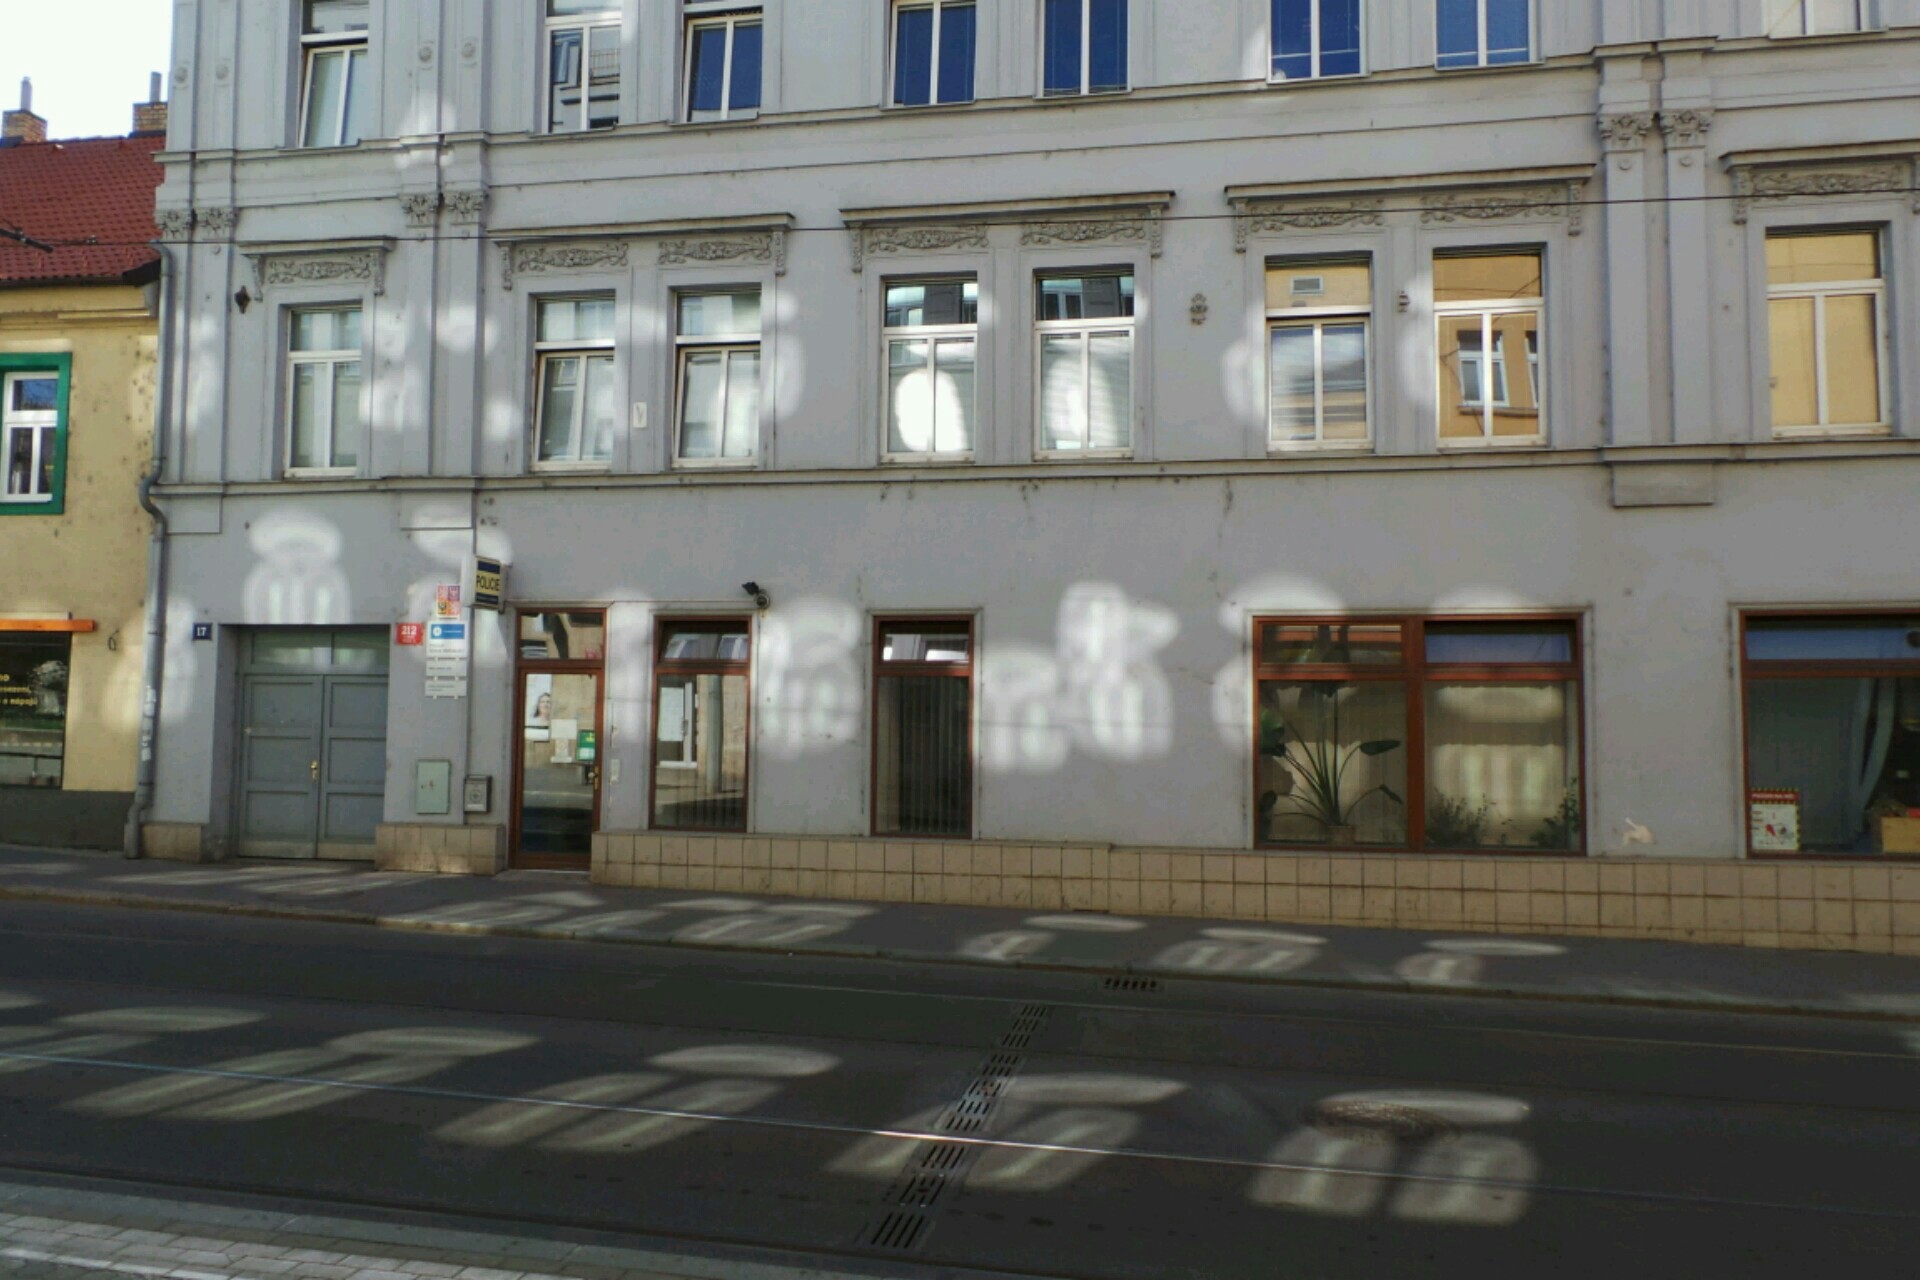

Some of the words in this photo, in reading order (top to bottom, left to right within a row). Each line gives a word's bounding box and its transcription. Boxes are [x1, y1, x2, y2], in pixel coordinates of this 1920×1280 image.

[476, 574, 501, 591] POLICIE
[197, 626, 207, 637] 17
[401, 625, 417, 635] 212
